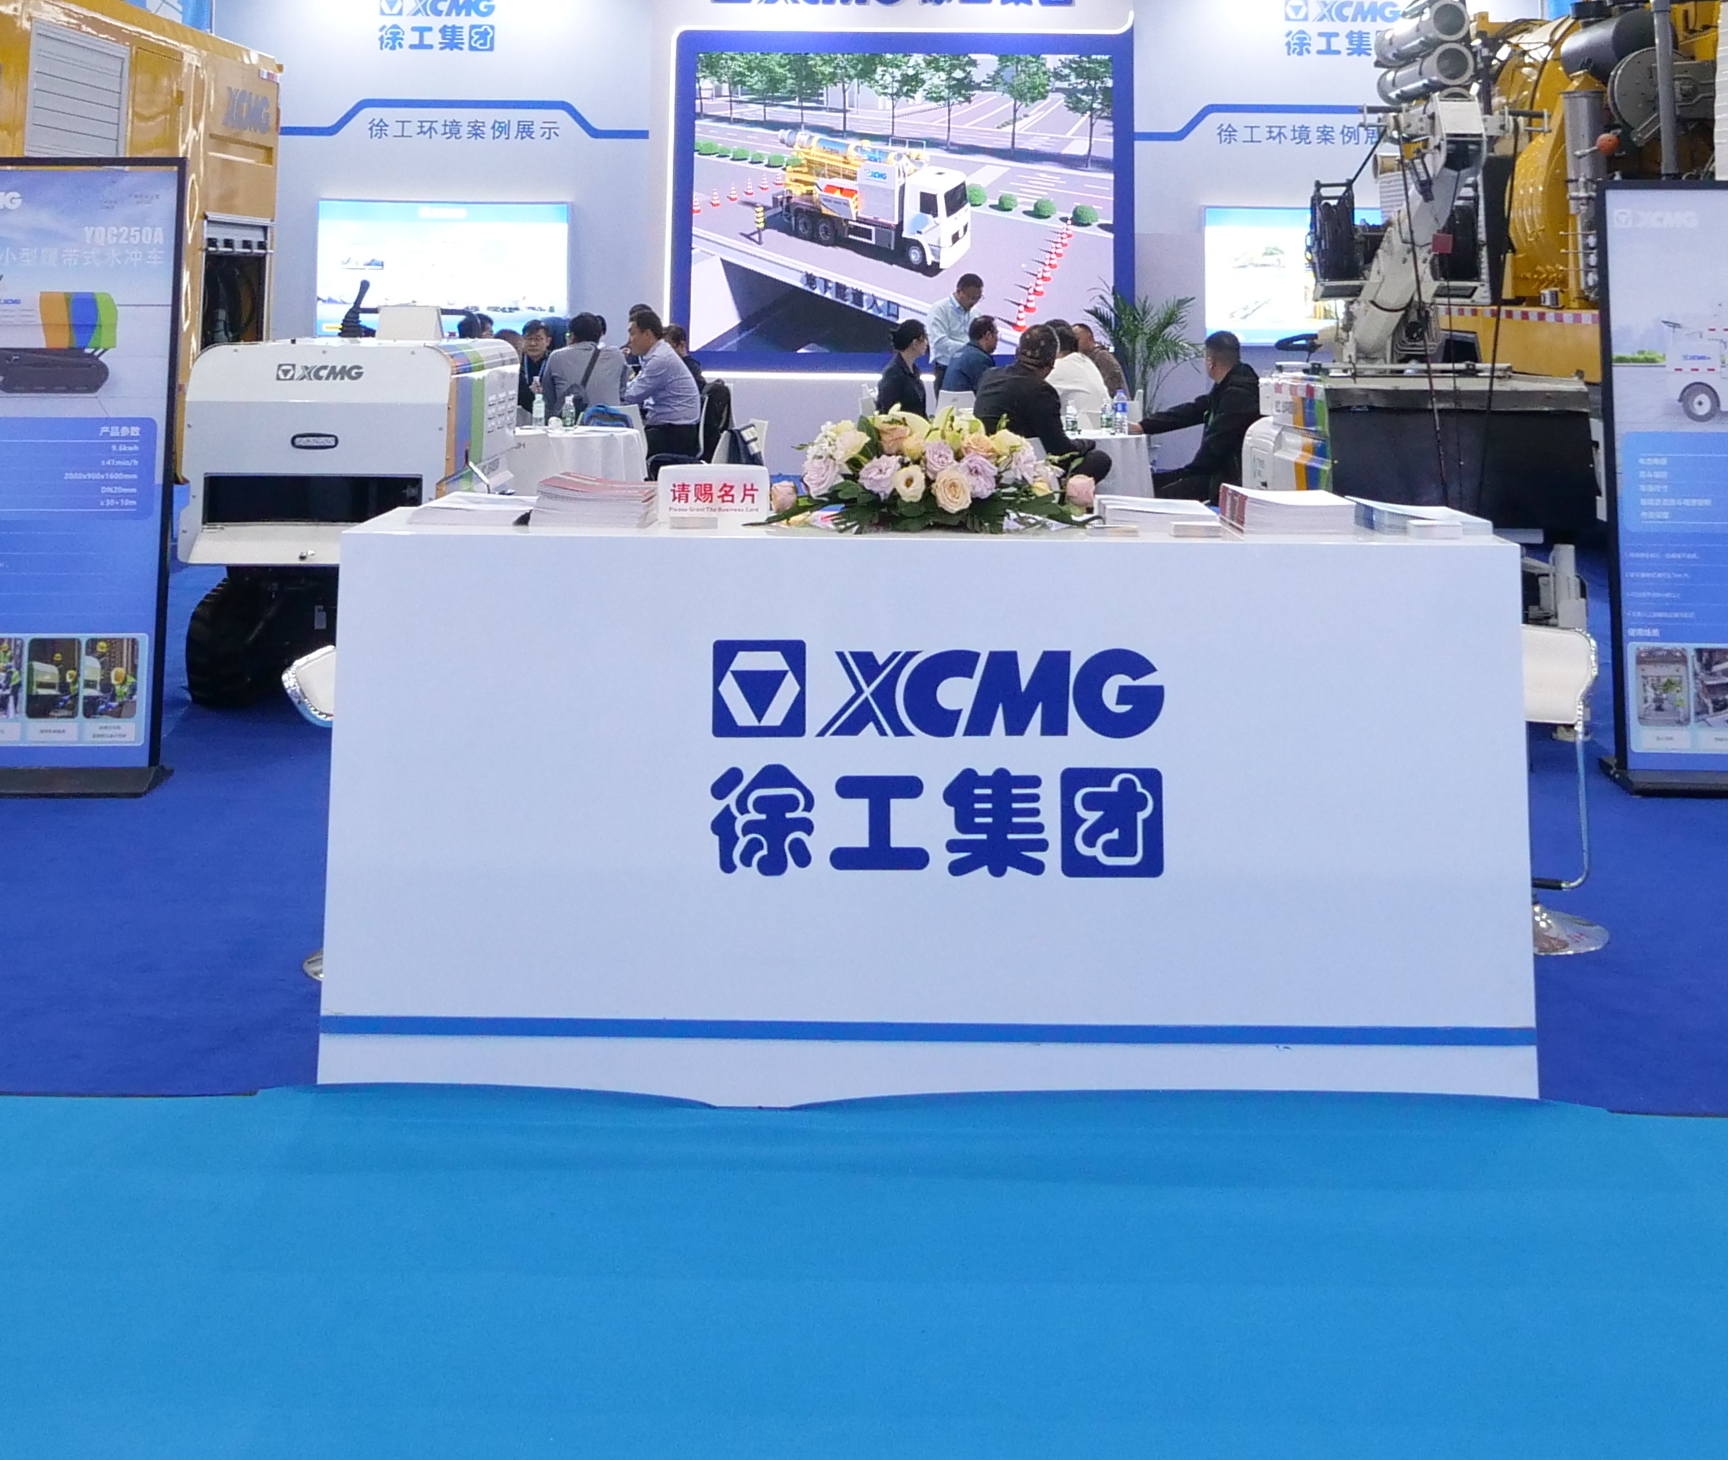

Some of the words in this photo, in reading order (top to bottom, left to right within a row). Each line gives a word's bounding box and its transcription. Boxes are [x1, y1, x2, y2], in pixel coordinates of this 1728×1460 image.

[1312, 0, 1401, 23] XCMG
[377, 24, 496, 52] 徐工集团
[1284, 29, 1381, 58] 徐工集
[221, 86, 271, 135] XCMG
[367, 117, 561, 141] 徐工环境案例展示
[1216, 123, 1384, 146] 徐工环境案例展
[84, 226, 164, 246] YQC250A
[296, 365, 365, 381] XCMG
[99, 426, 141, 437] 产品参数
[670, 482, 760, 504] 请赐名片
[815, 648, 1165, 740] XCMG
[710, 763, 1165, 878] 徐工集团
